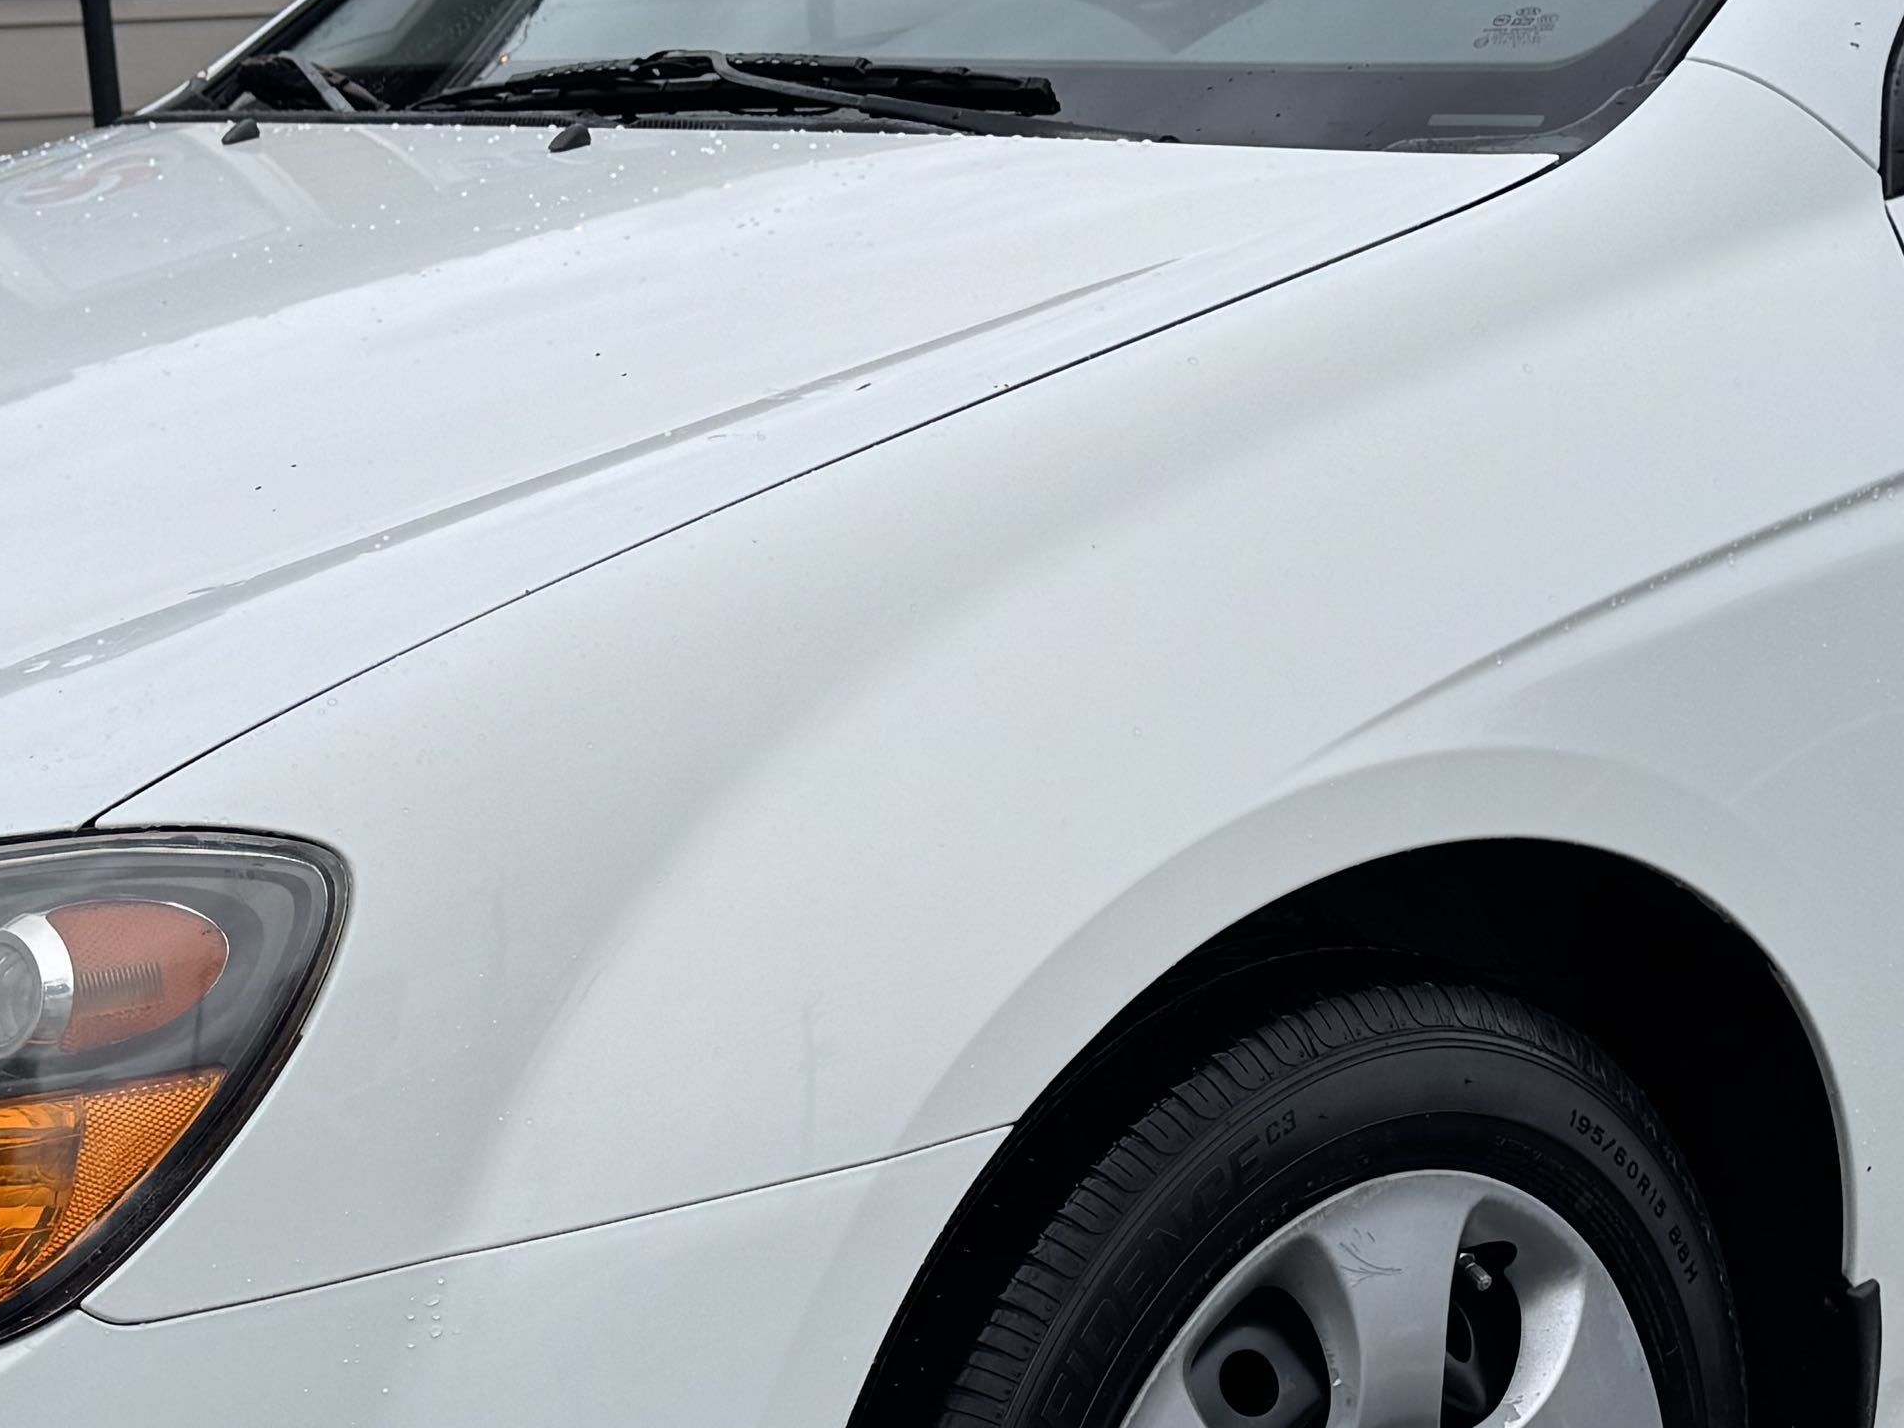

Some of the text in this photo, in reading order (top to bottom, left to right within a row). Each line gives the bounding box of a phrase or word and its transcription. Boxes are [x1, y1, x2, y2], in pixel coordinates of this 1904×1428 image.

[1264, 1109, 1298, 1150] C3
[1568, 1107, 1668, 1220] 195/60R15
[1667, 1224, 1699, 1285] 88H
